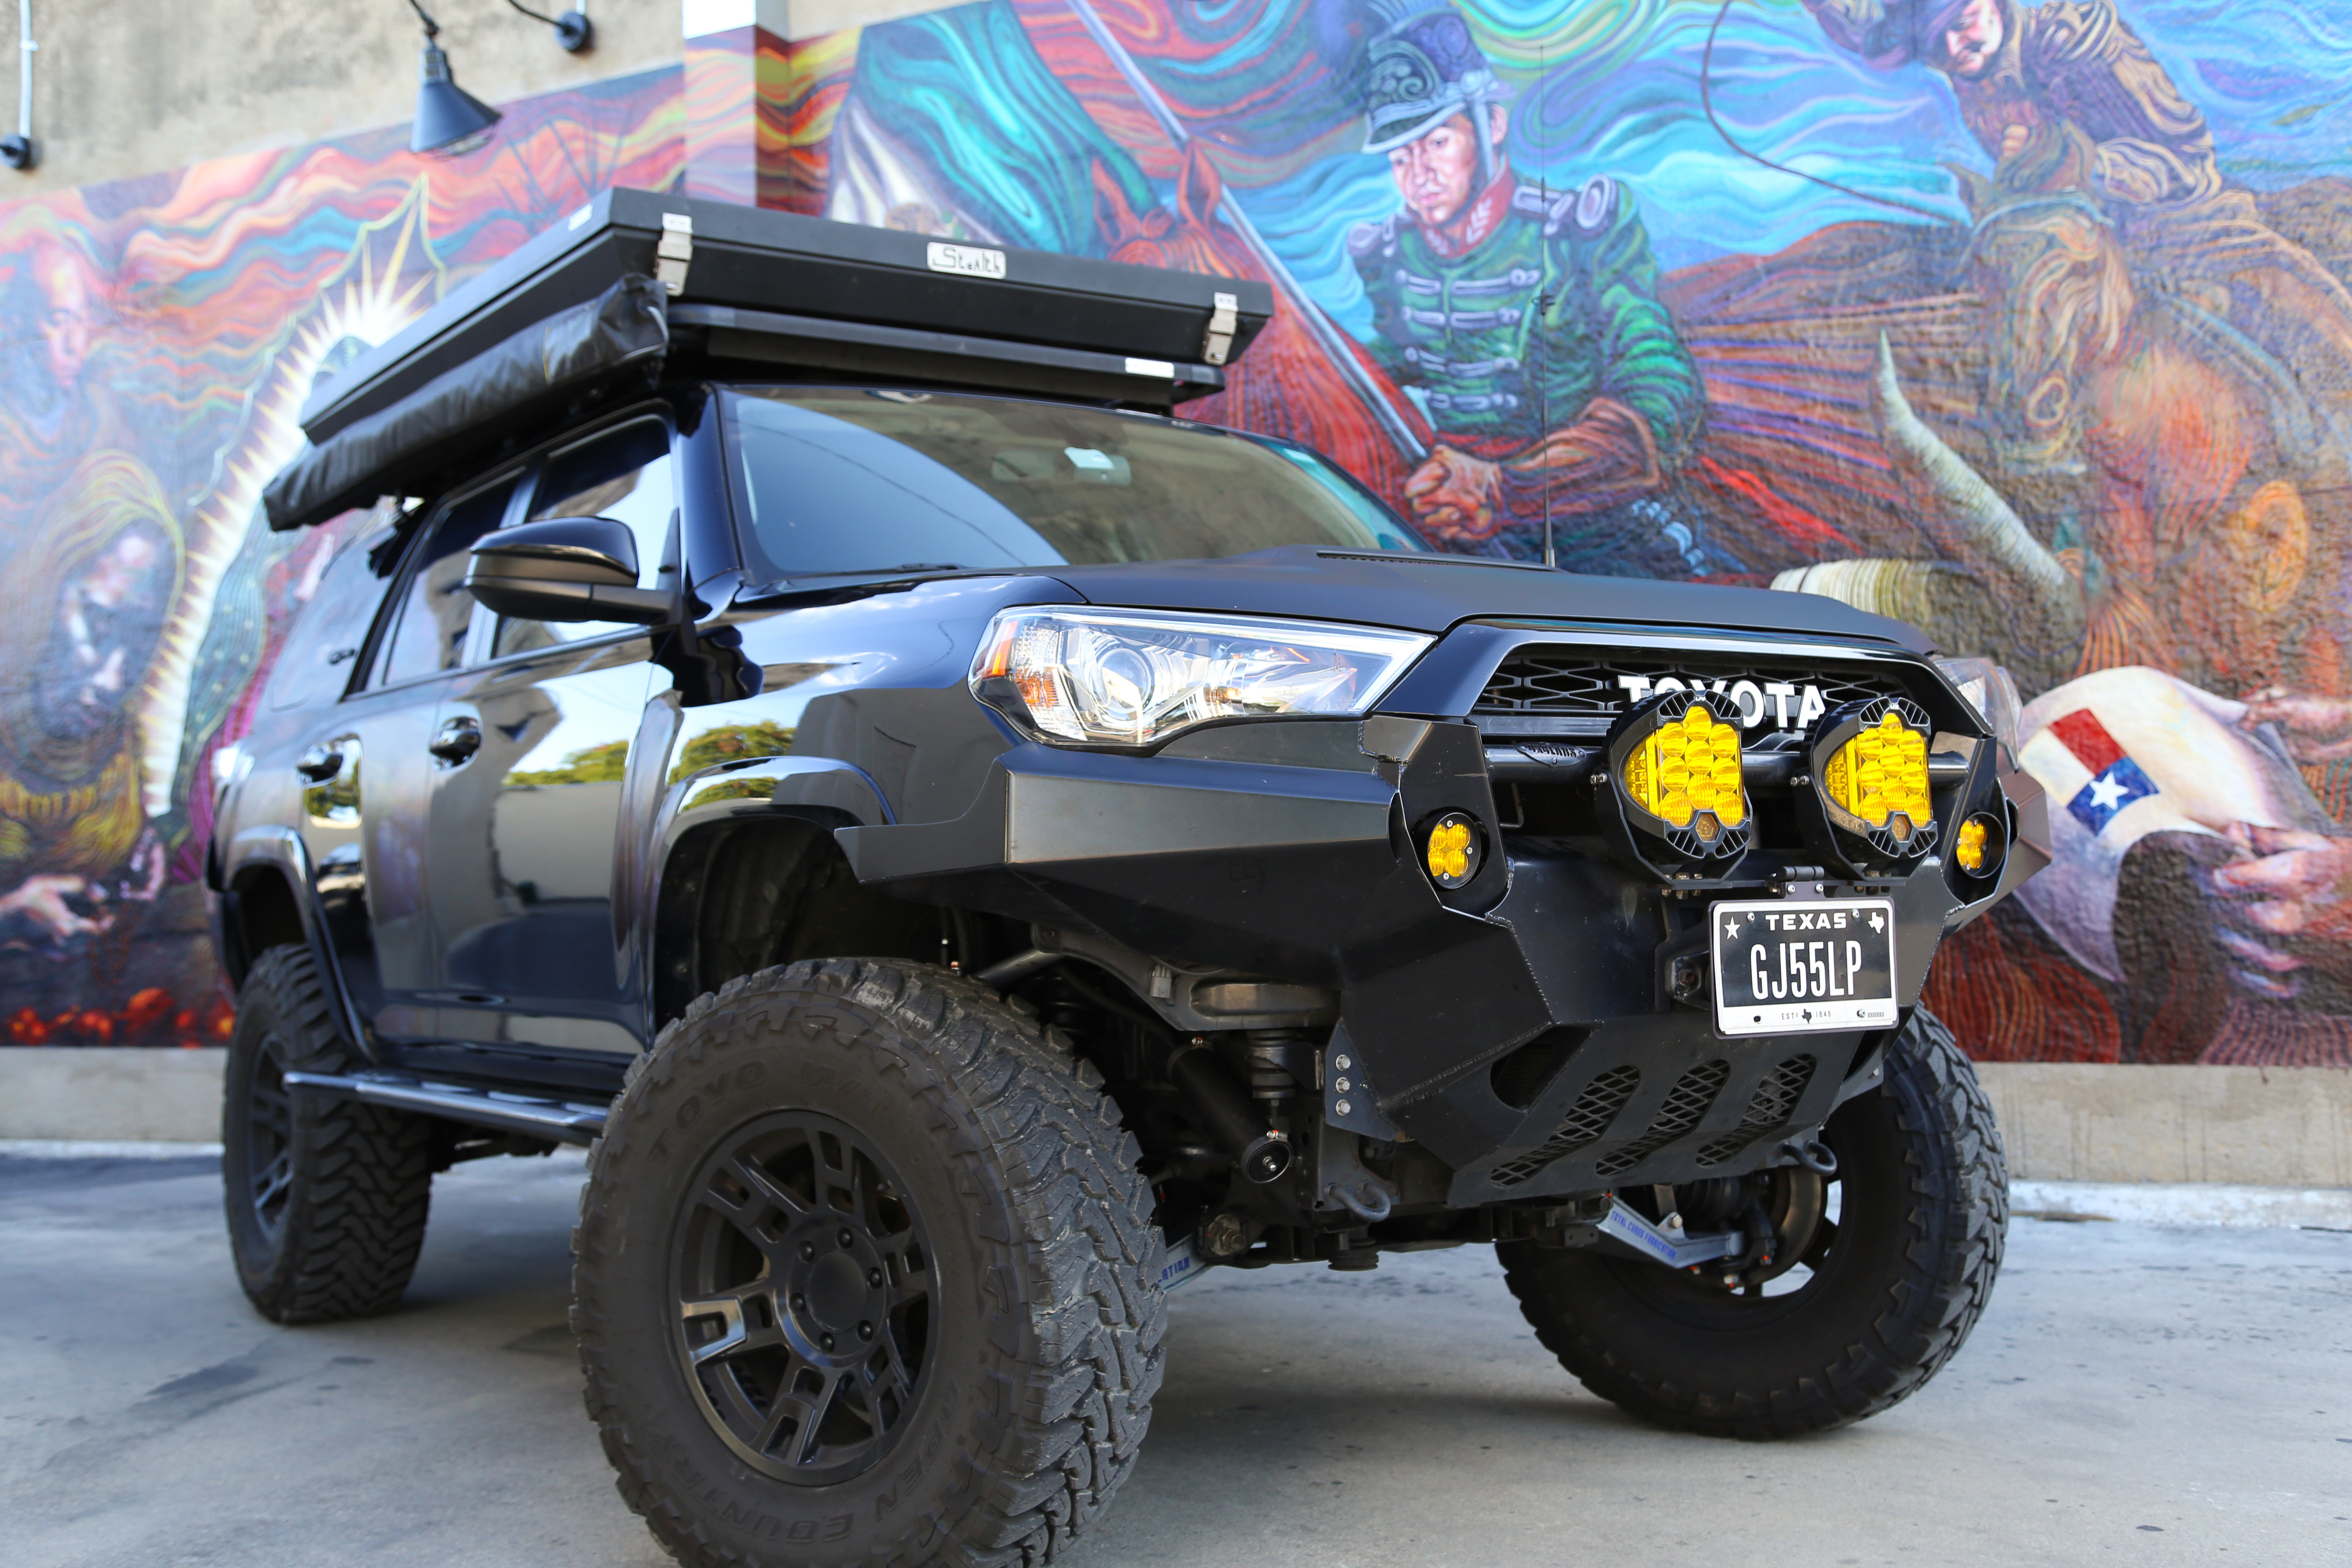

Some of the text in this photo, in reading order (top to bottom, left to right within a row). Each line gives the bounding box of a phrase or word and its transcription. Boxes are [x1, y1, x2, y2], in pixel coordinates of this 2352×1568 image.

[1618, 675, 1825, 729] TOTA
[1765, 912, 1847, 931] TEXAS
[1750, 940, 1862, 1000] GJ55LP
[1611, 1211, 1627, 1228] TOTAL
